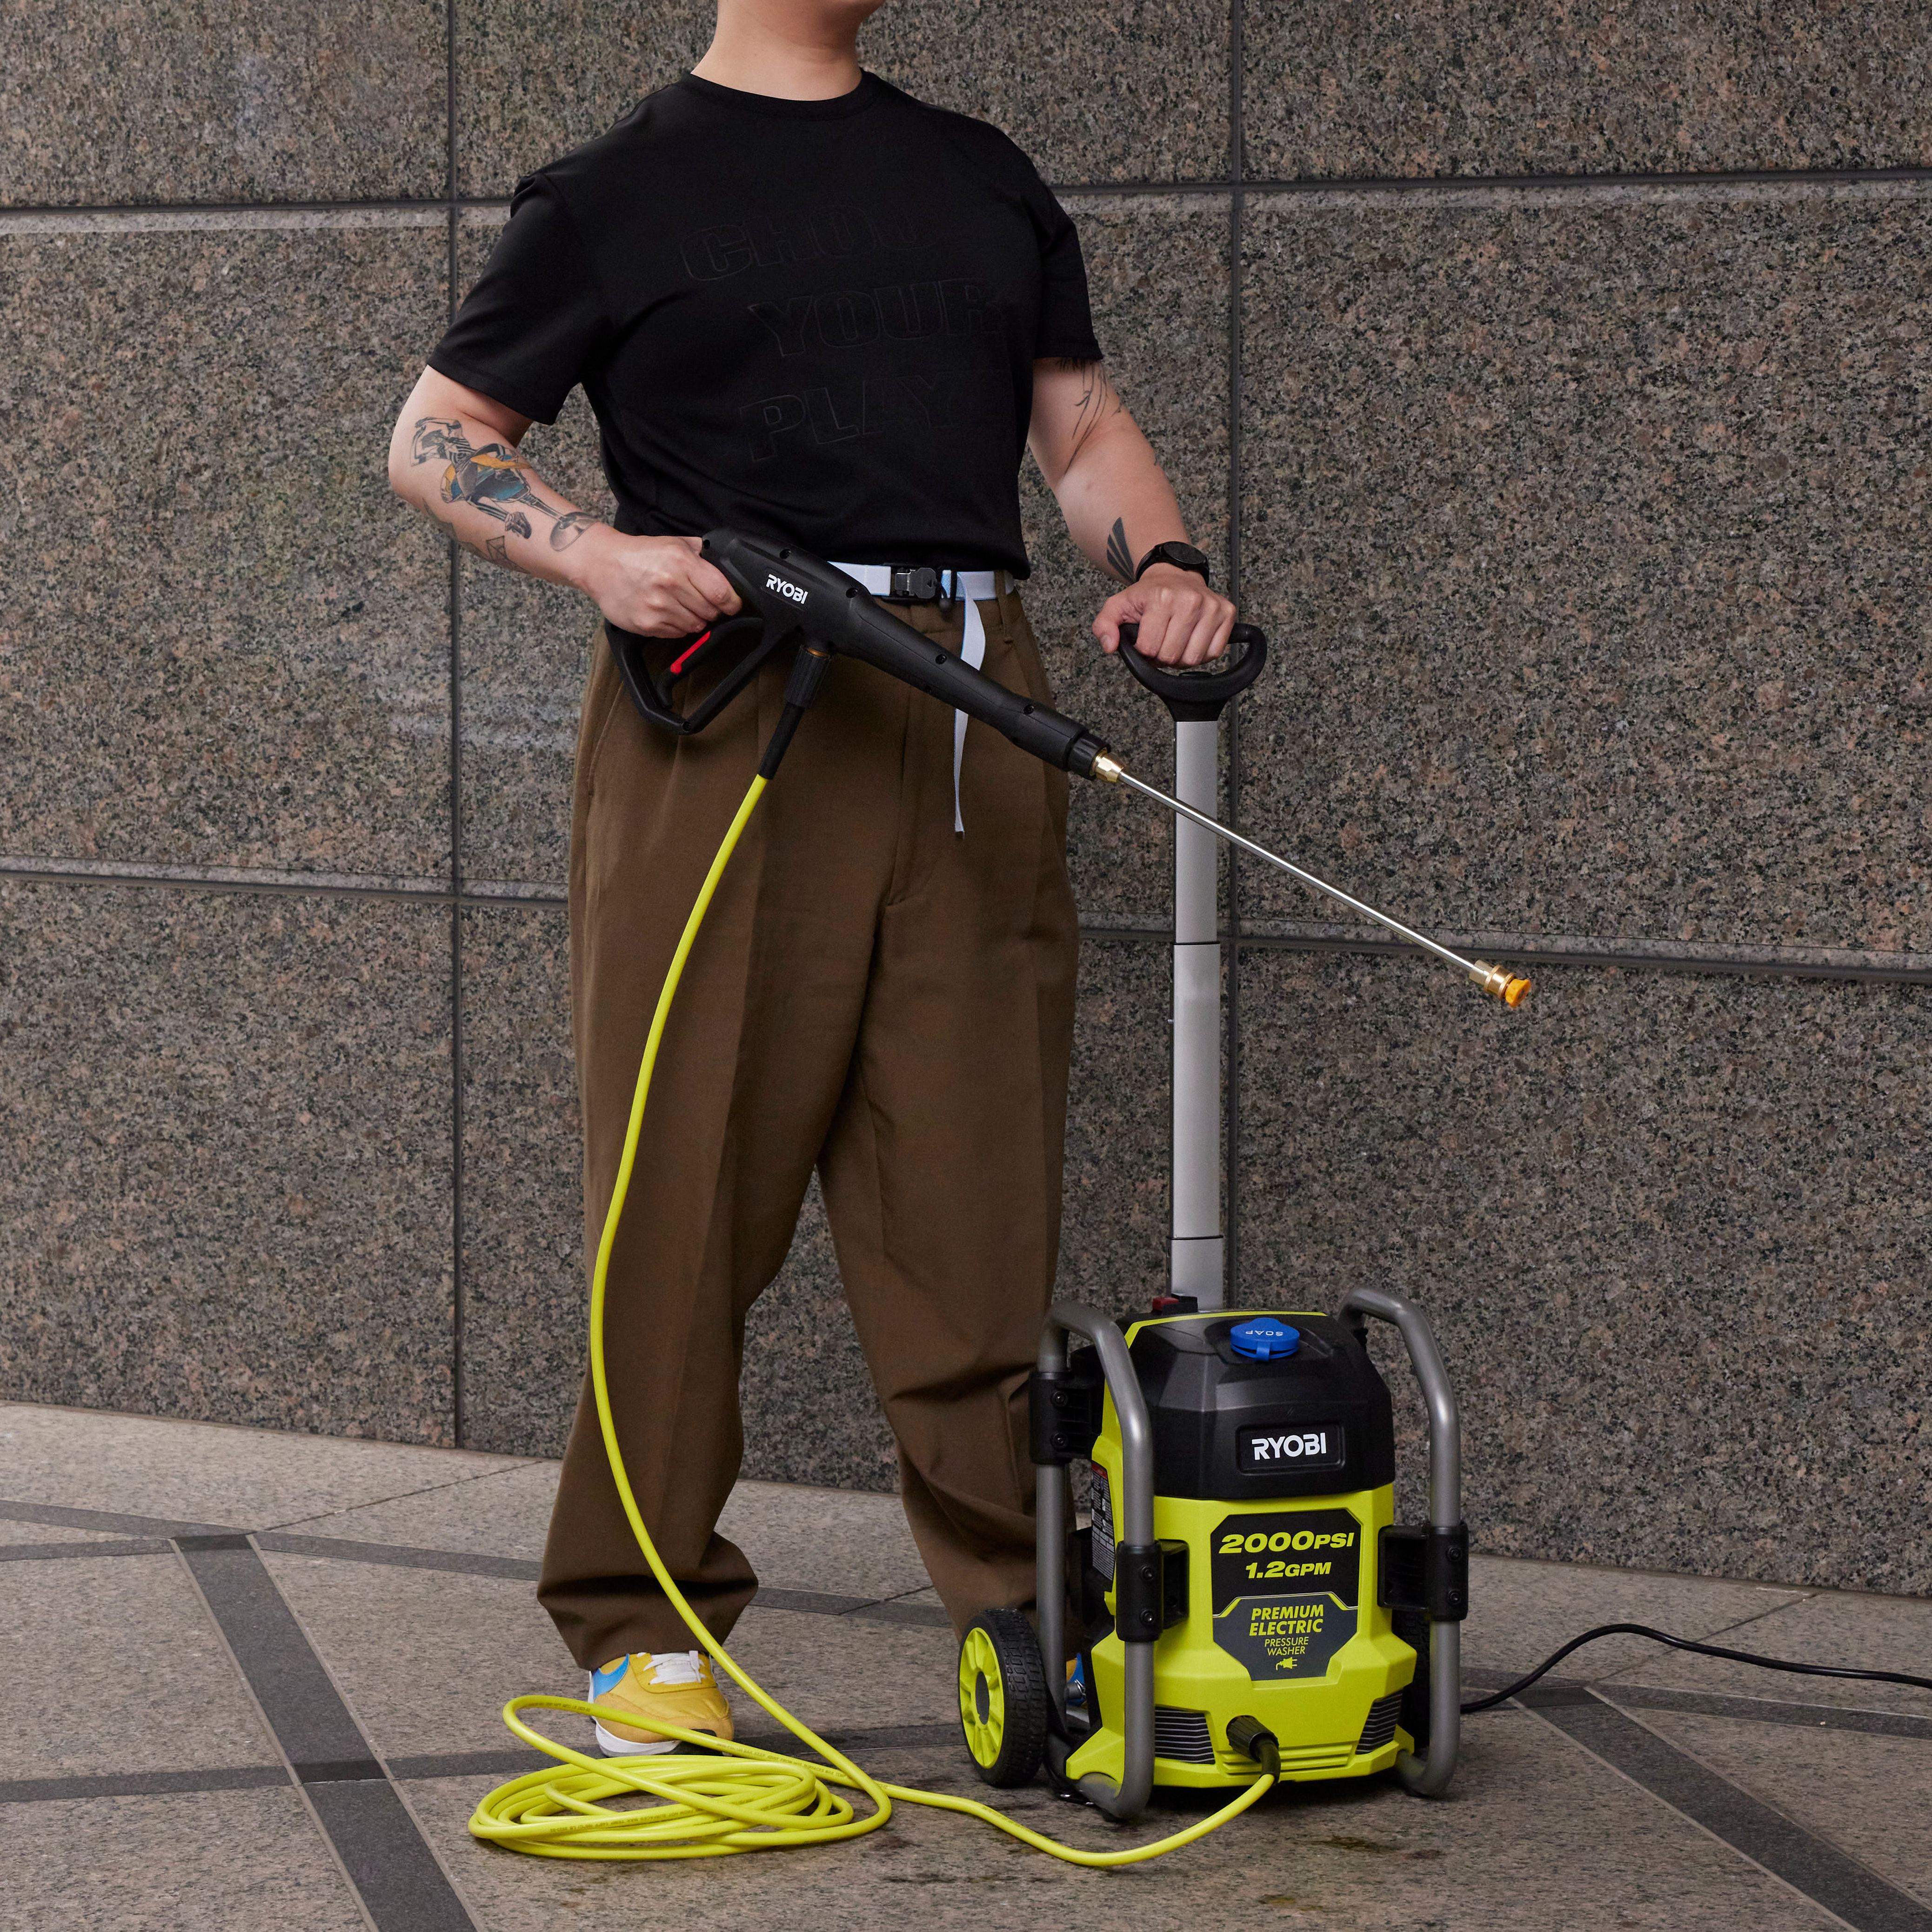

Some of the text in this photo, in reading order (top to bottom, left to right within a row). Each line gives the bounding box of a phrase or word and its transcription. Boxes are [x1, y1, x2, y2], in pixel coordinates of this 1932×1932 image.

[747, 277, 1007, 358] YOUR
[739, 371, 954, 463] PLAY
[766, 573, 809, 605] RYOBI
[1251, 1432, 1327, 1460] RYOBI
[1218, 1530, 1355, 1554] 2000PSI
[1245, 1561, 1332, 1579] 1.2GPM
[1251, 1604, 1324, 1621] PREMIUM
[1249, 1619, 1324, 1636] ELECTRIC
[1264, 1636, 1309, 1647] PRESSURE
[1267, 1646, 1306, 1656] WASHER
